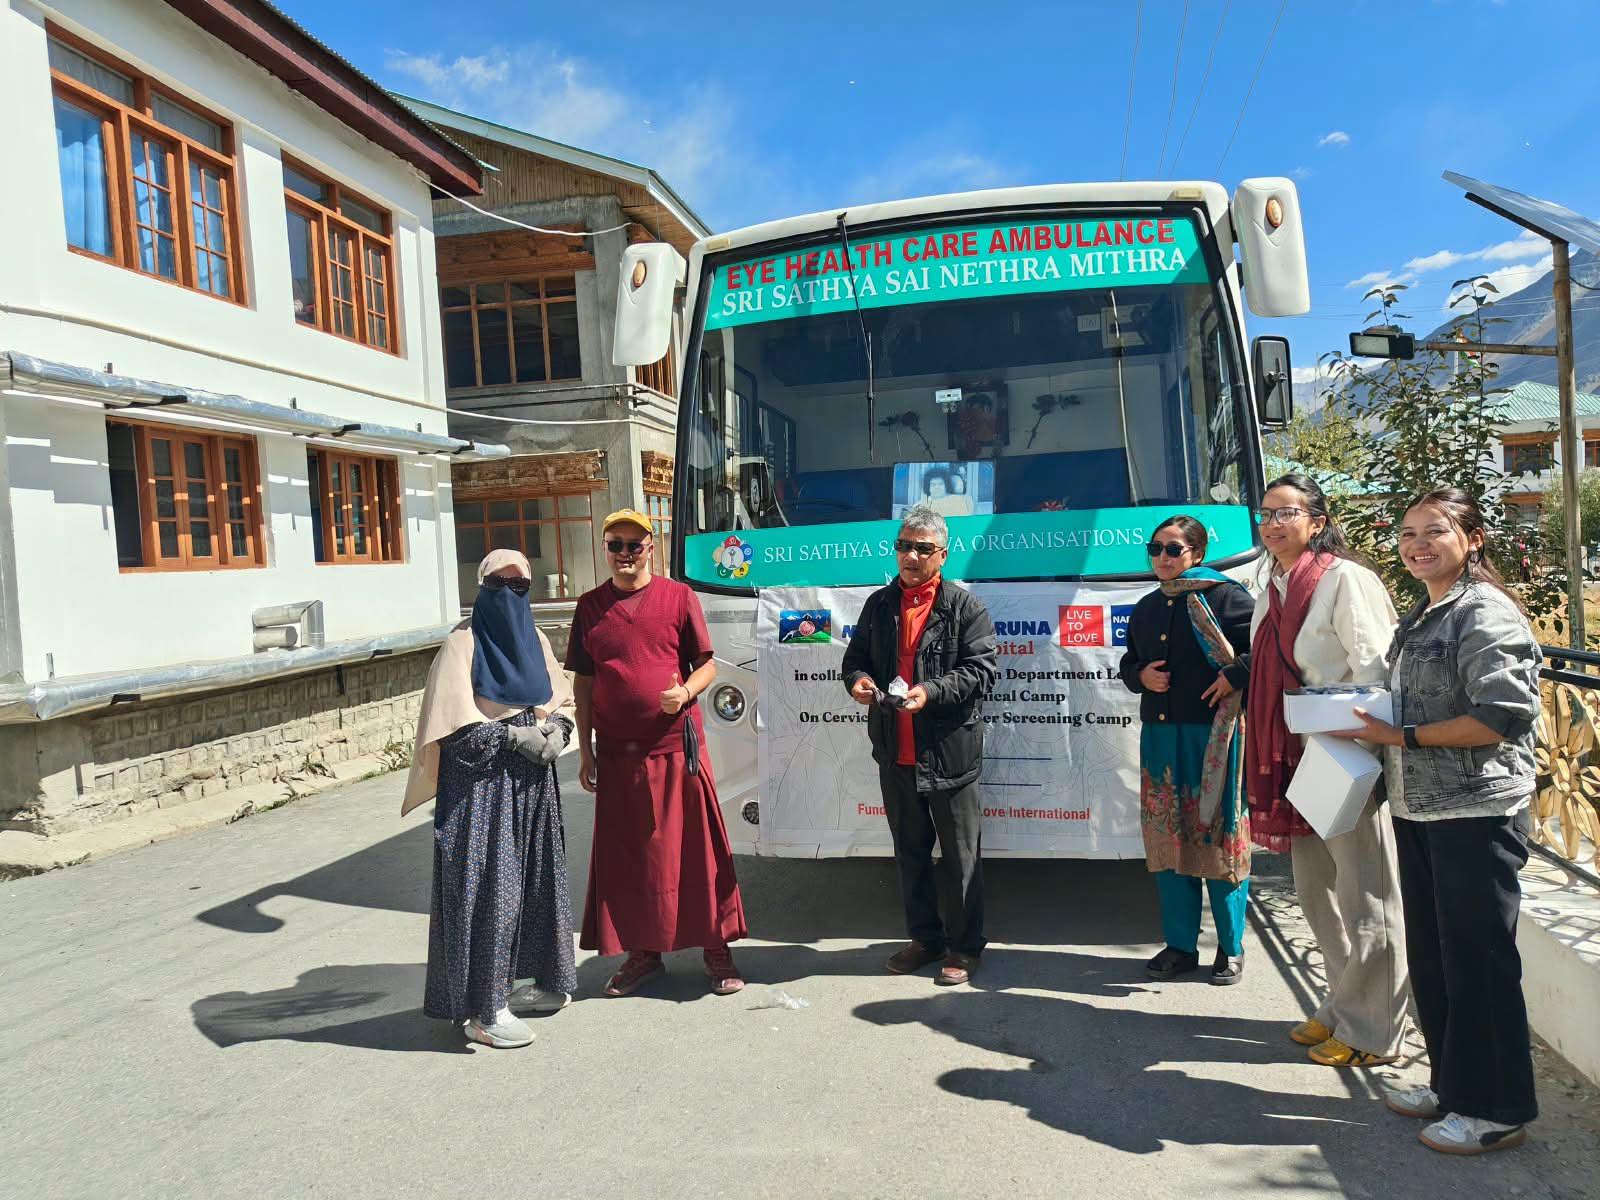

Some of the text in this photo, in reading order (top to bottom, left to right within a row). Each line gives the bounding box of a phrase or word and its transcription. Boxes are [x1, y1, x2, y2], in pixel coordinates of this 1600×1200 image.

[727, 219, 1175, 290] EYE HEALTH CARE AMBULANCE
[722, 247, 1186, 317] SRI SATHYA SAI NETHRA MITHRA
[764, 546, 793, 563] SRI
[799, 541, 872, 560] SATHYA
[1066, 610, 1093, 620] LIVE
[994, 620, 1052, 636] RUNA
[1066, 622, 1084, 631] TO
[1067, 633, 1099, 643] LOVE
[794, 670, 808, 681] in
[1006, 668, 1103, 684] Department
[1020, 690, 1066, 706] Camp
[800, 711, 819, 723] On
[822, 711, 870, 723] Cervic
[1002, 711, 1082, 727] Screening
[1085, 712, 1132, 729] Camp
[1008, 806, 1091, 820] International
